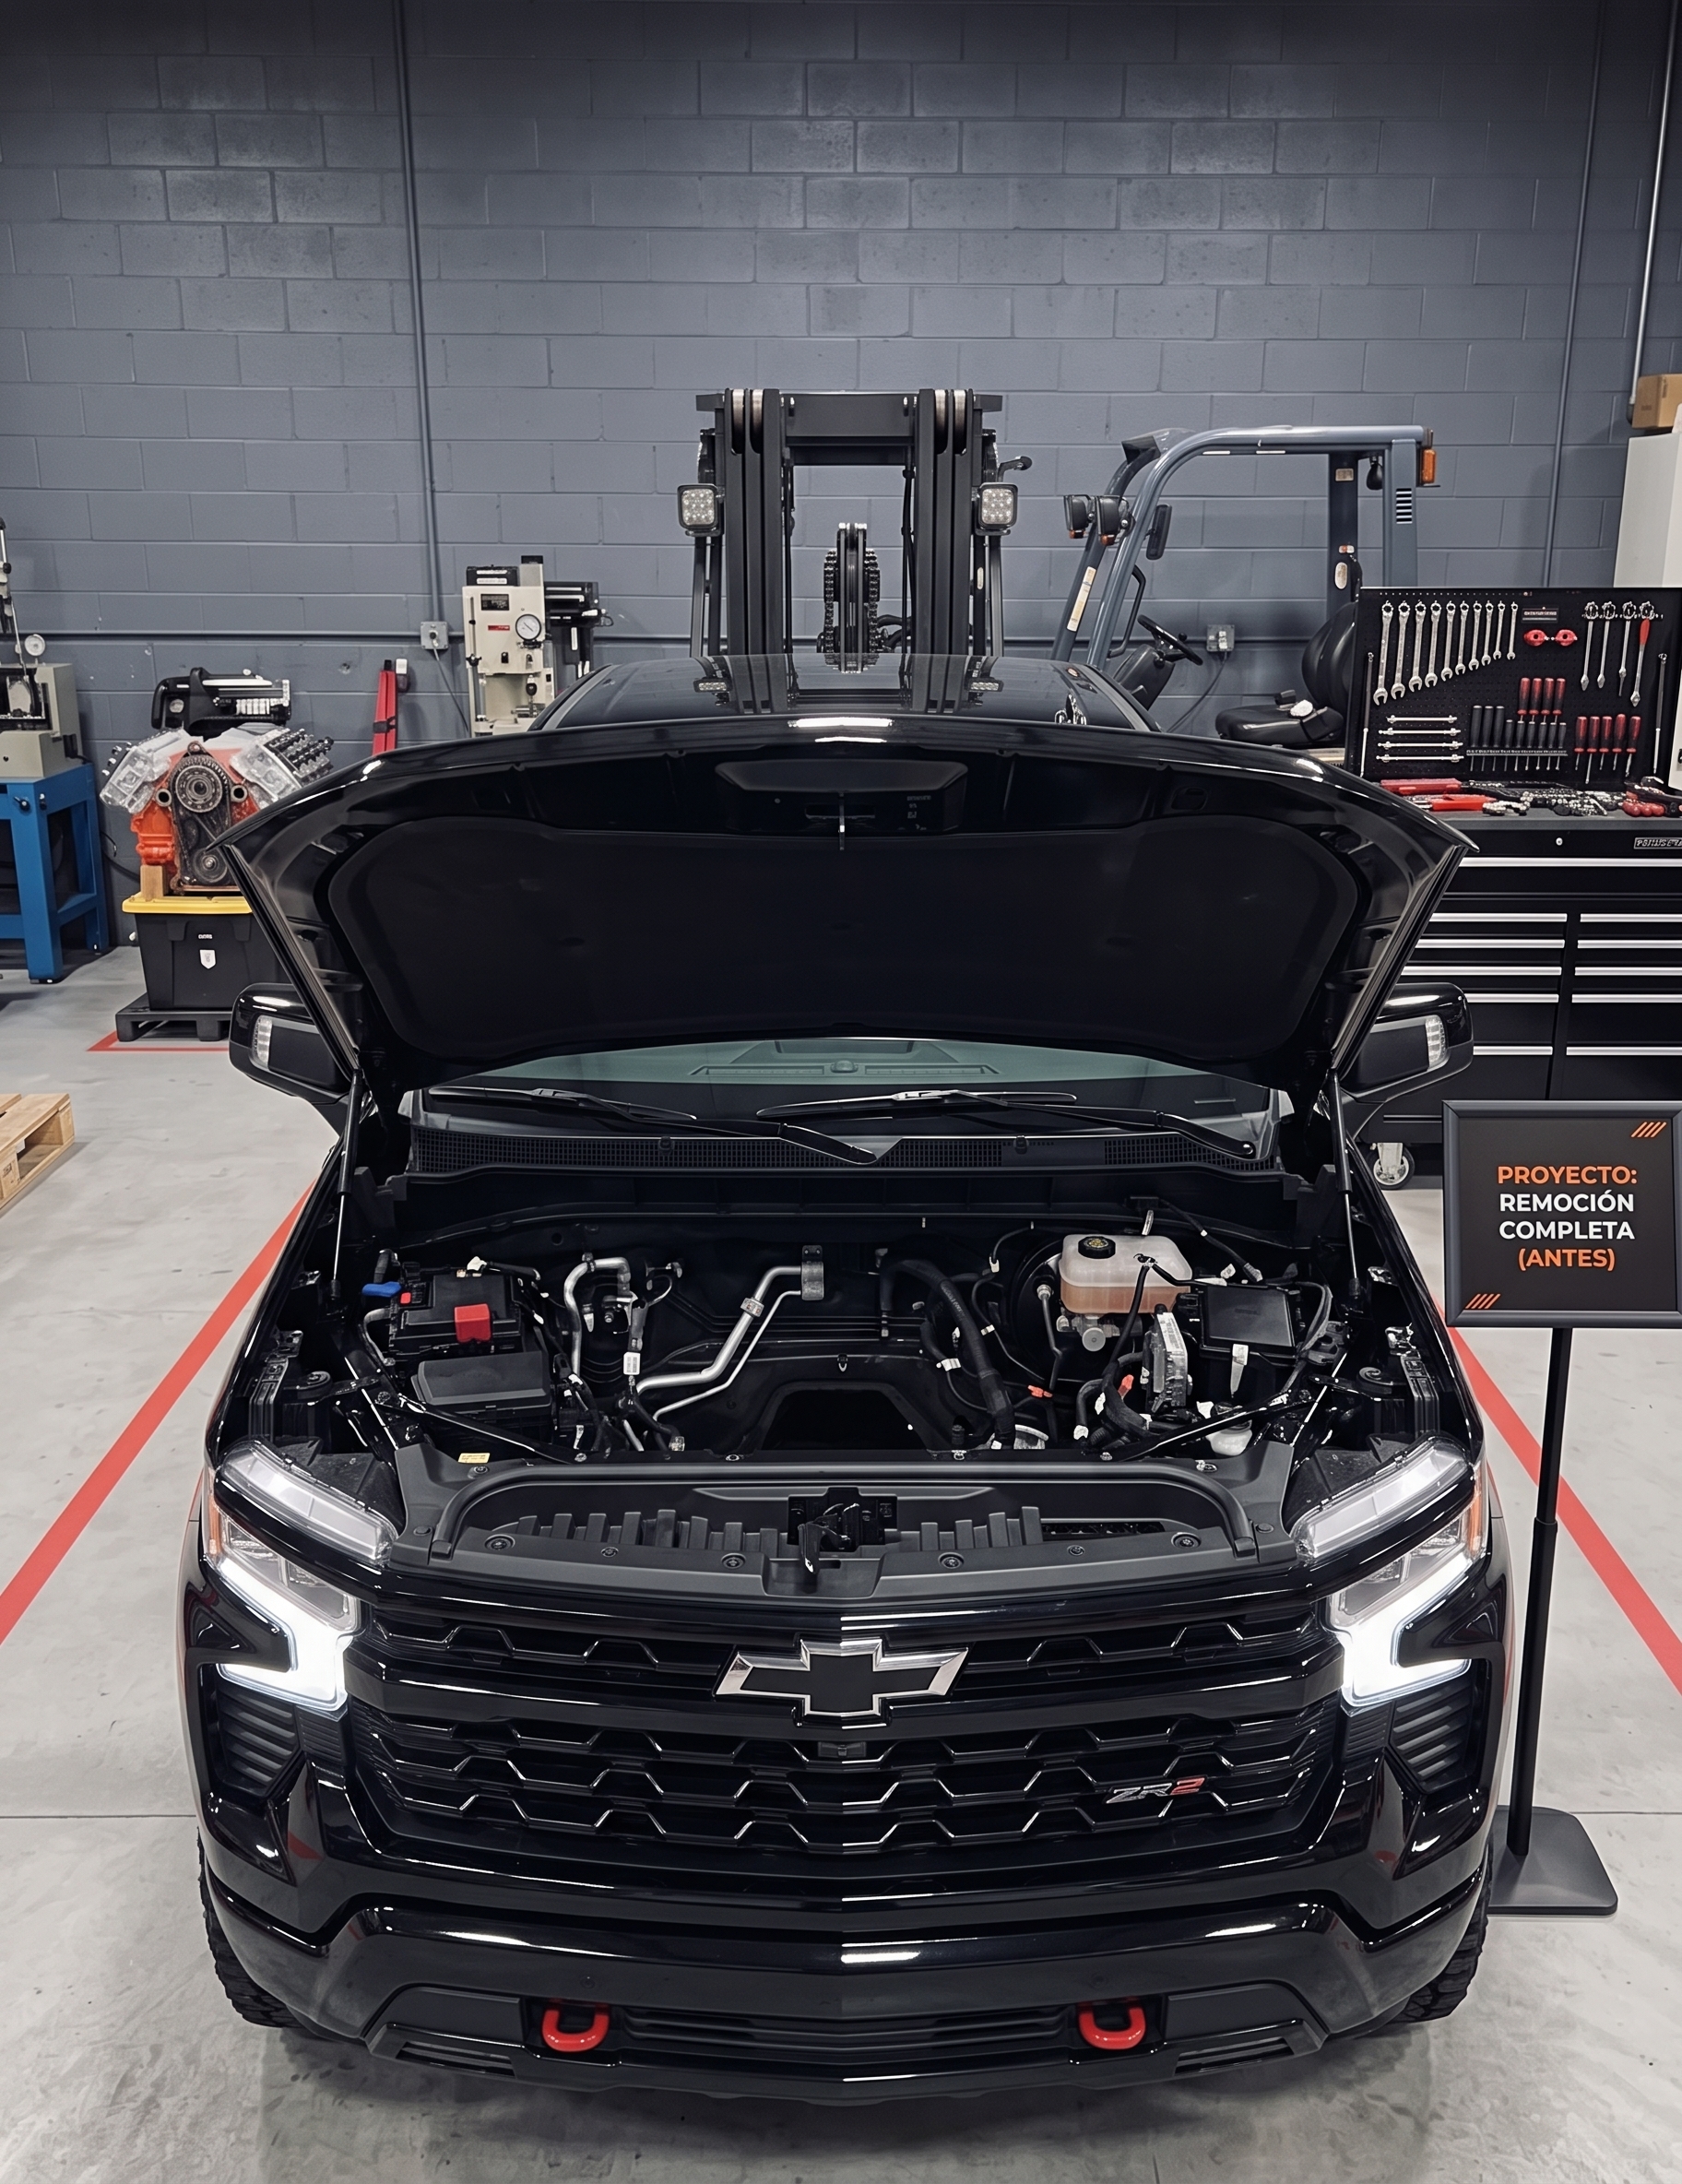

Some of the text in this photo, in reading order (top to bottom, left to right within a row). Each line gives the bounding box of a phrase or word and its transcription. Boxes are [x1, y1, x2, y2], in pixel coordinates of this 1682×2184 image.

[1498, 1165, 1638, 1185] PROYECTO:
[1498, 1189, 1634, 1212] REMOCIÓN
[1498, 1220, 1636, 1240] COMPLETA
[1518, 1247, 1616, 1272] (ANTES)
[1106, 1777, 1205, 1804] ZR2
